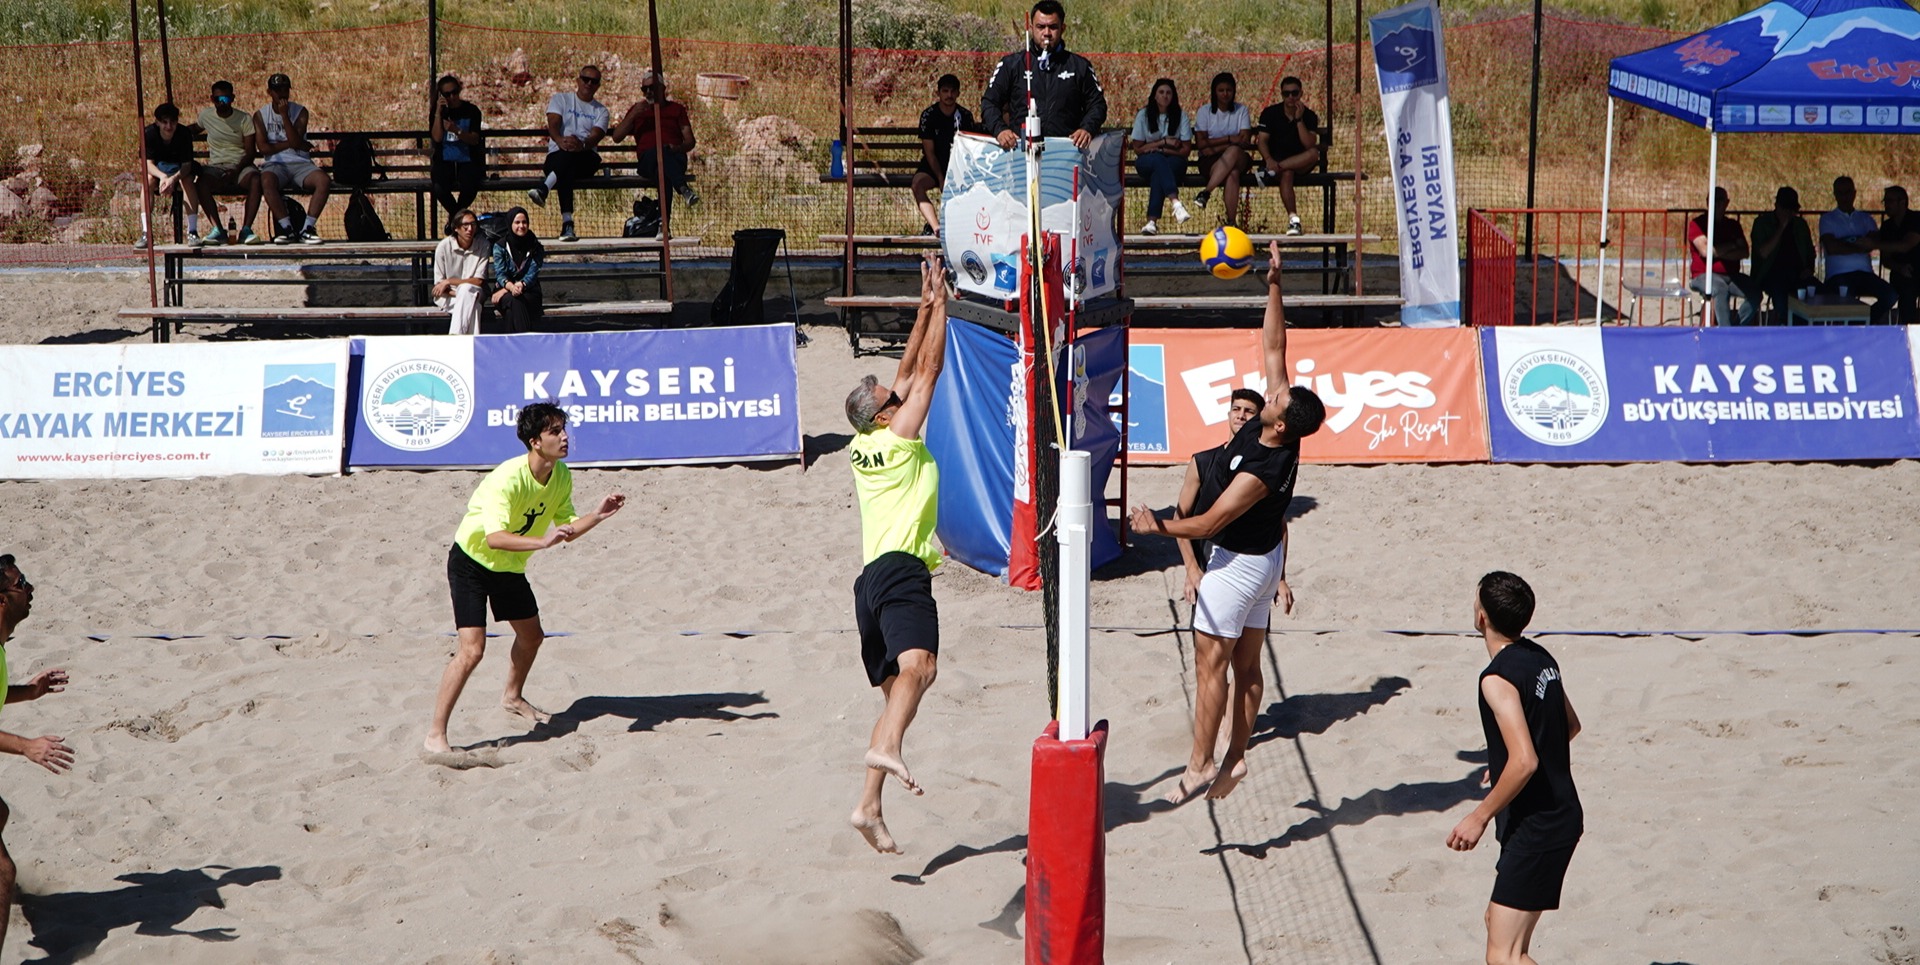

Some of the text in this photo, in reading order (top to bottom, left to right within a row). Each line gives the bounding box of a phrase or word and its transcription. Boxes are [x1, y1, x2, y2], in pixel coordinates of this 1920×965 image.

[973, 233, 993, 245] TVF
[53, 365, 185, 397] ERCİYES
[523, 357, 736, 400] KAYSERİ
[1509, 354, 1602, 418] KAYSERİ BÜYÜKŞEHİR BELEDİYESİ
[1653, 356, 1858, 394] KAYSERİ
[371, 363, 467, 424] KAYSERİ BÜYÜKŞEHİR BELEDİYESİ
[1623, 395, 1903, 425] BÜYÜKŞEHİR BELEDİYESİ
[0, 405, 243, 438] KAYAK MERKEZİ
[487, 393, 781, 428] BÜŞEHİR BELEDİYESİ
[405, 437, 431, 446] 1869
[1363, 410, 1461, 450] Ski Resort
[1547, 432, 1572, 440] 1869
[17, 451, 211, 463] www.kayserierciyes.com.tr
